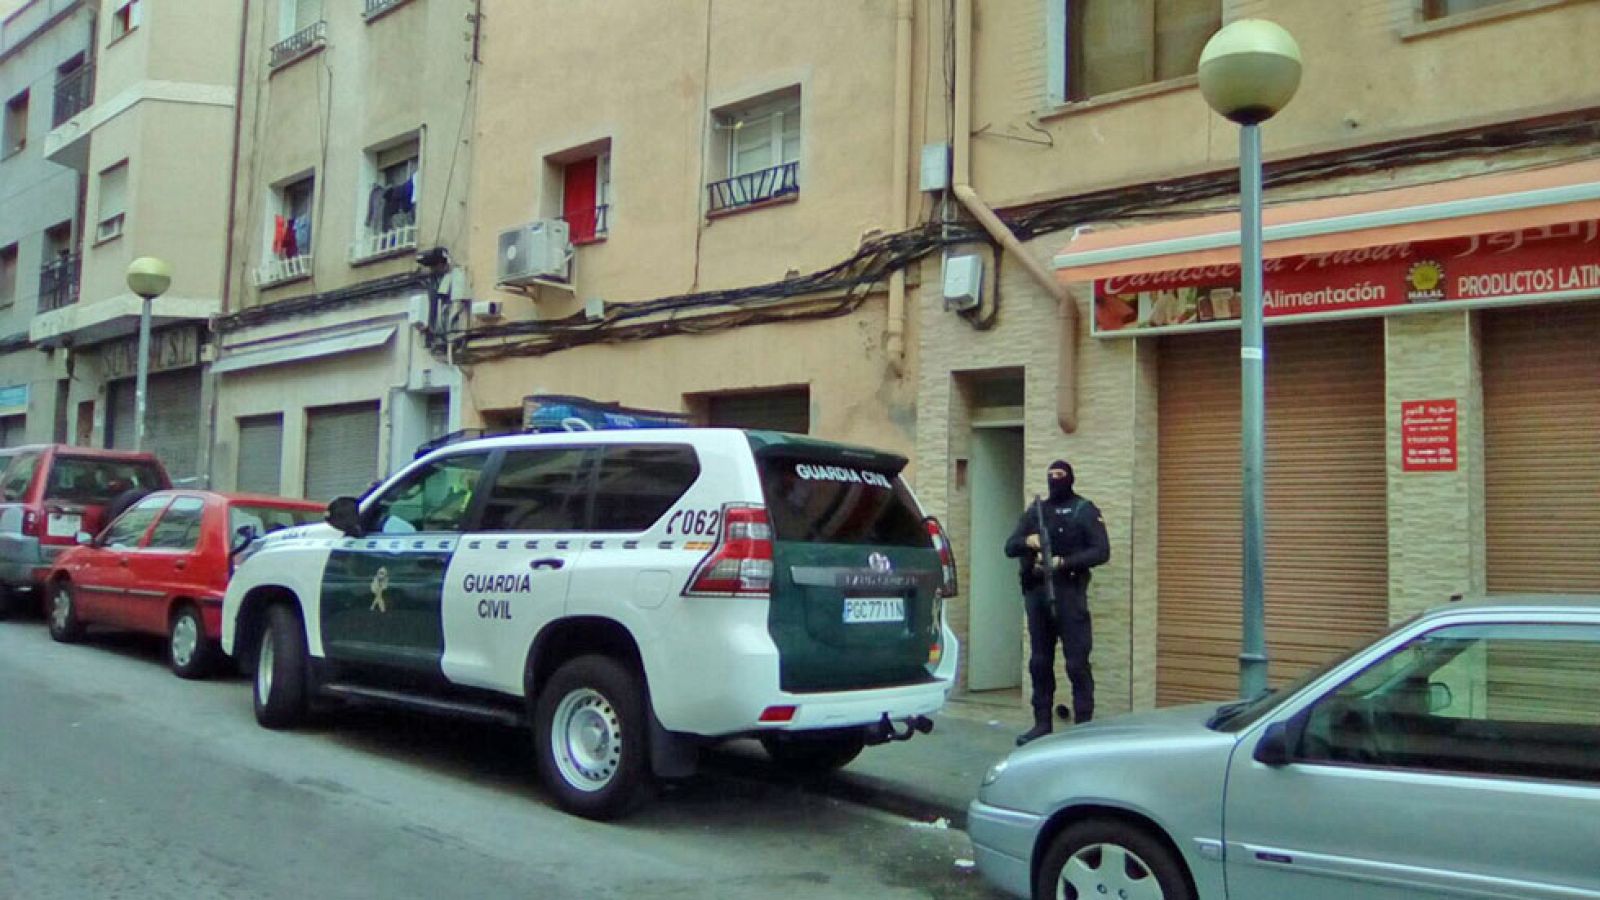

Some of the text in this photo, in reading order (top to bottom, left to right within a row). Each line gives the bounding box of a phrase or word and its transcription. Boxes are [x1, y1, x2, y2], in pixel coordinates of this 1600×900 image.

[1263, 281, 1385, 308] Alimentación
[1457, 267, 1554, 297] PRODUCTOS
[795, 463, 892, 490] GUARDIA CIVIL
[681, 509, 719, 535] 062
[463, 574, 531, 593] GUARDIA
[478, 600, 512, 620] CIVIL
